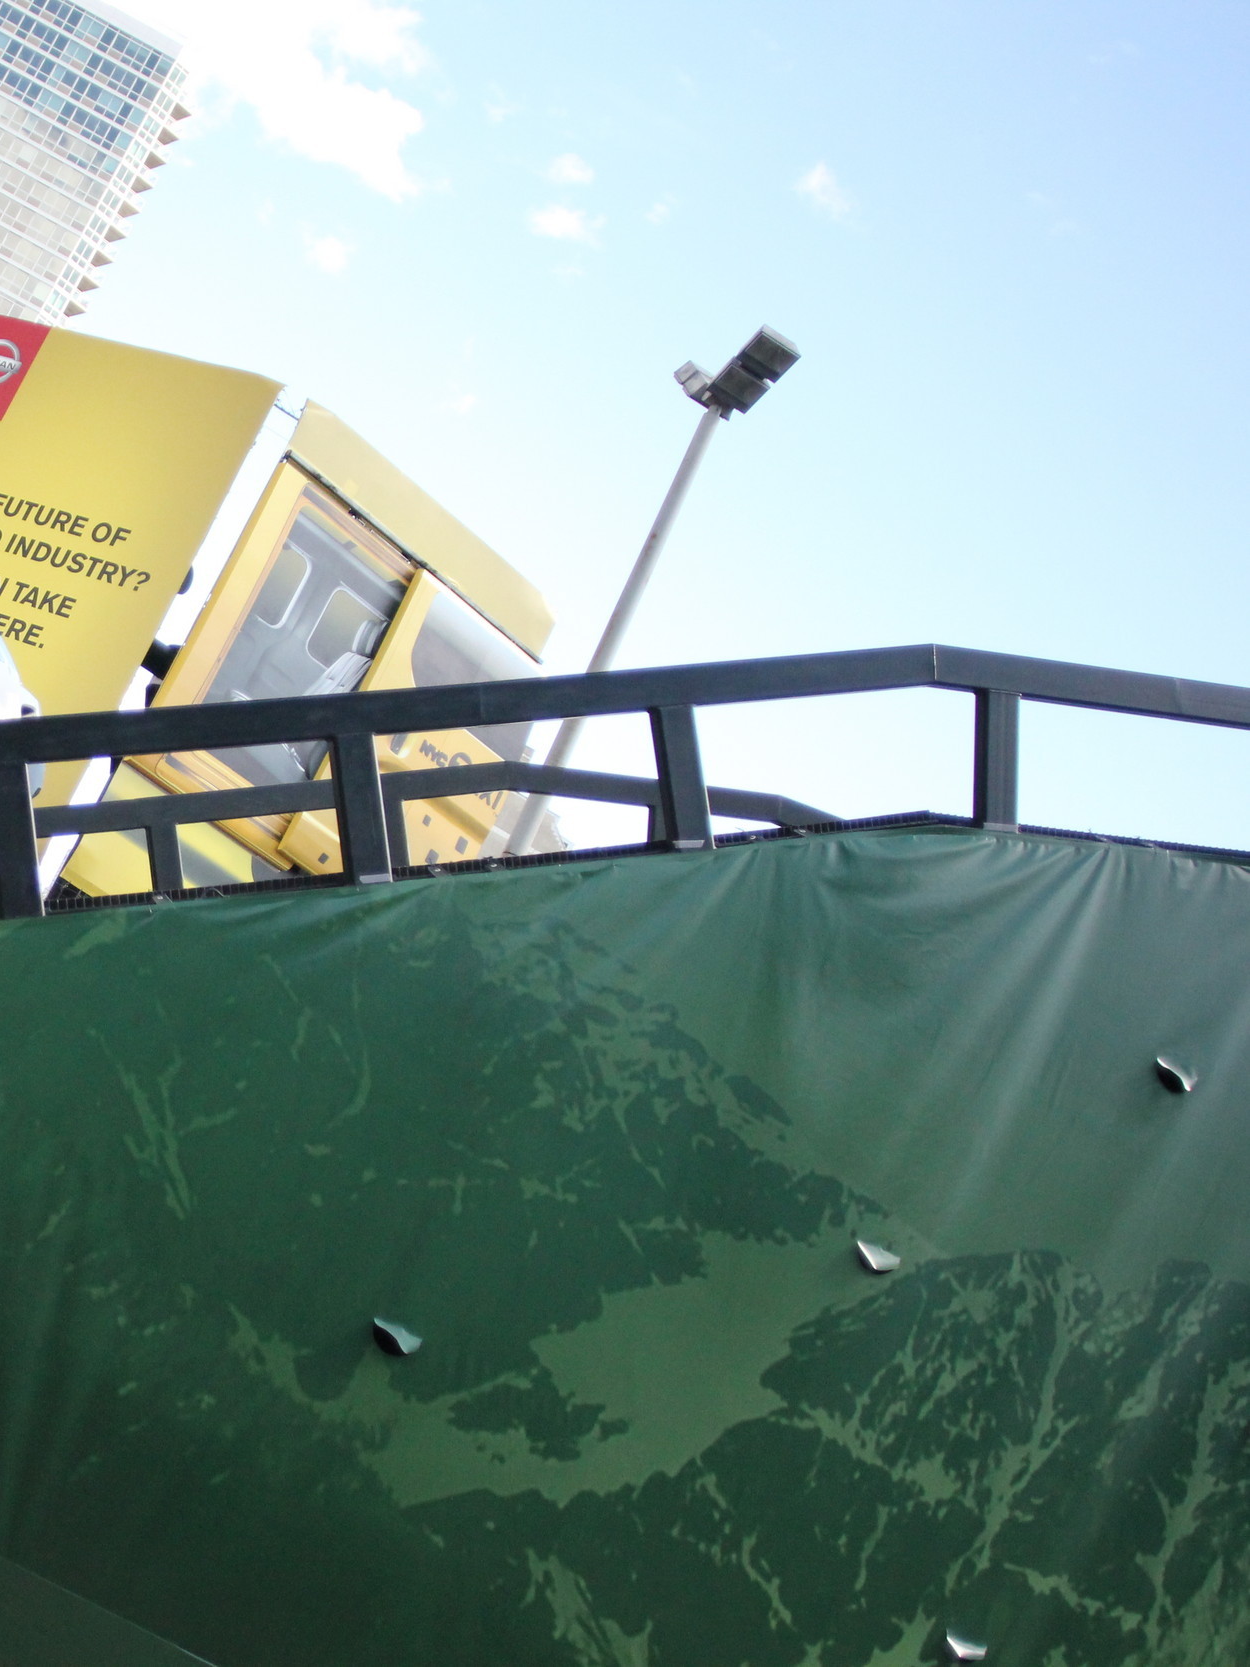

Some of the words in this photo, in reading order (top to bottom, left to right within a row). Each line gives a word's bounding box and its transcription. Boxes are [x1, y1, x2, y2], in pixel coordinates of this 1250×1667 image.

[91, 521, 132, 548] OF
[5, 533, 151, 592] INDUSTRY?
[11, 581, 77, 619] TAKE
[419, 739, 448, 768] NYC
